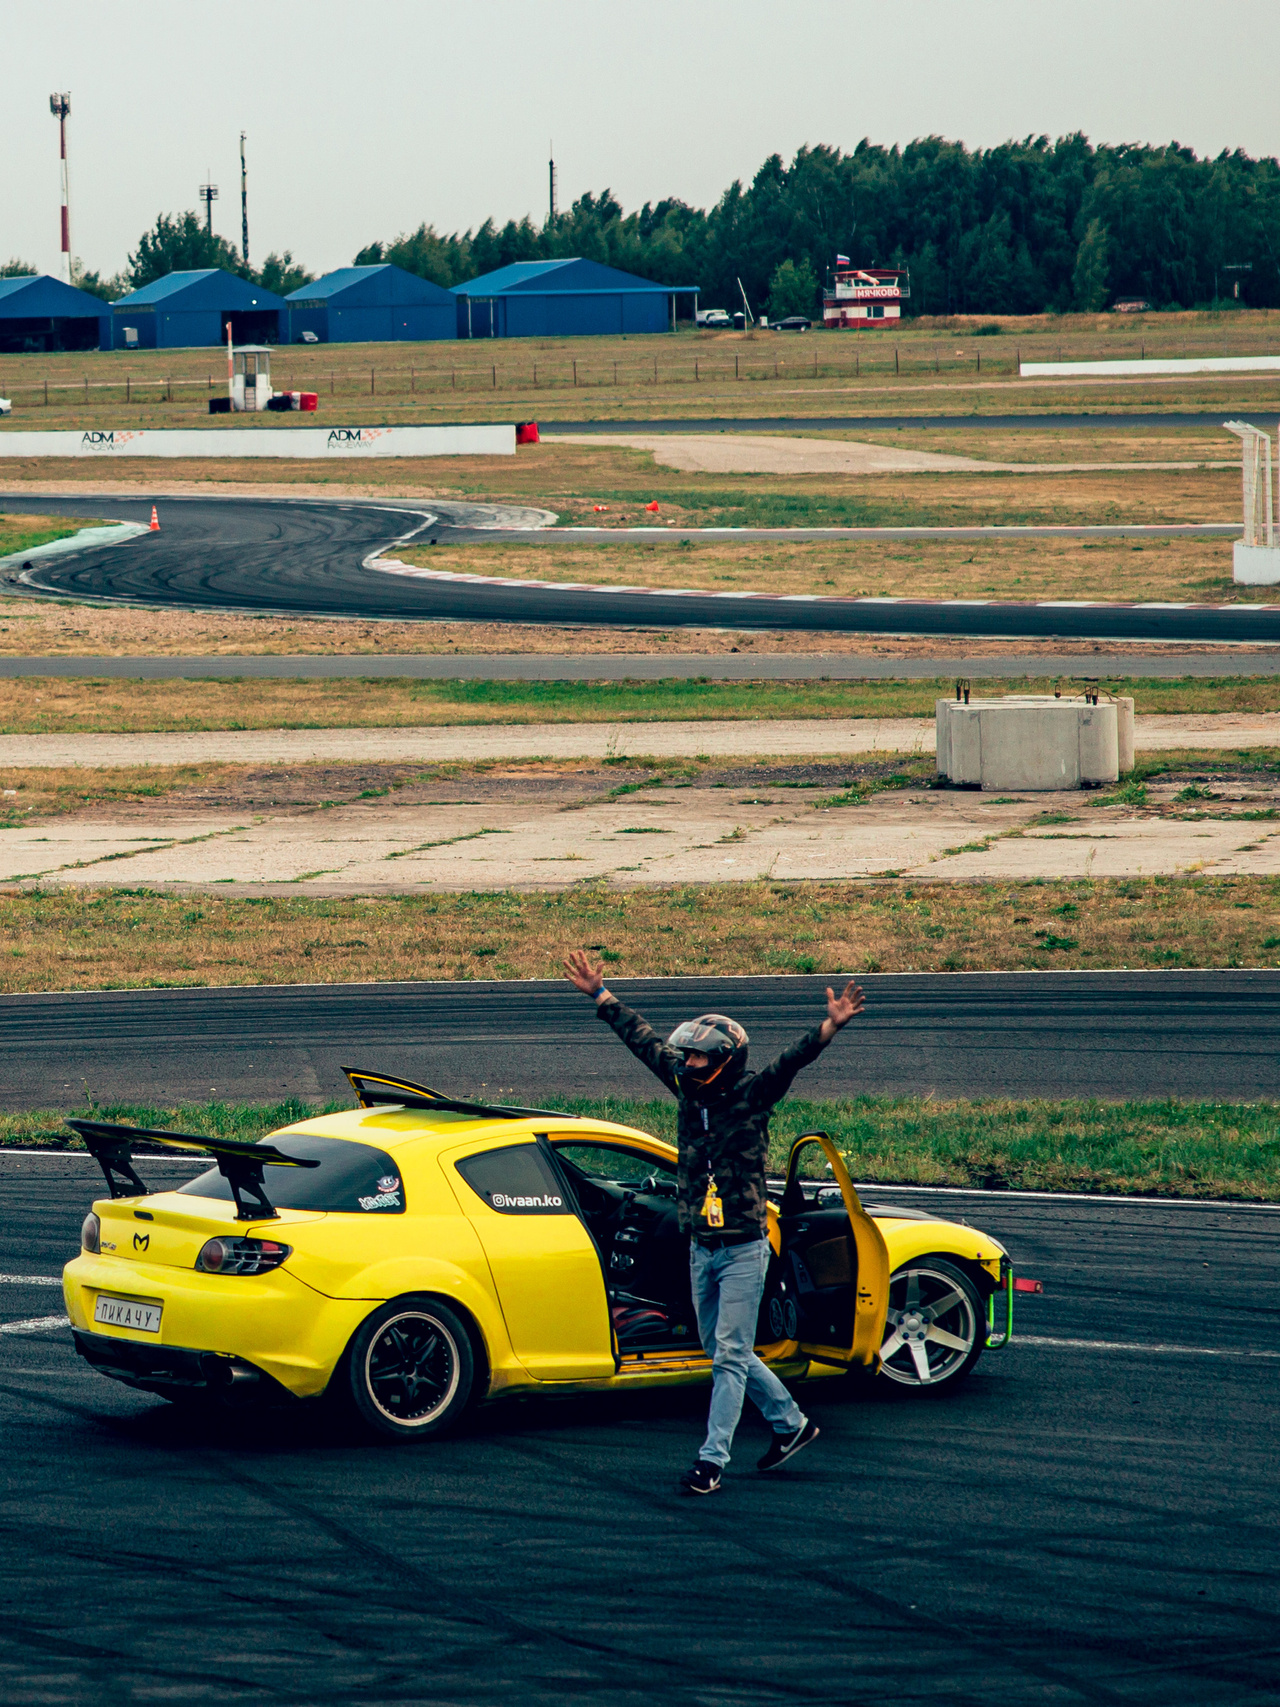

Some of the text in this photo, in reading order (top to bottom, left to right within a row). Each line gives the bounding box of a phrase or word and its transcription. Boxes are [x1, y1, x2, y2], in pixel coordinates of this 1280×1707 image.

[857, 288, 900, 298] МЯЧКОВО
[81, 431, 114, 443] ADM
[327, 429, 361, 441] ADM
[80, 443, 126, 451] RACEWAY
[327, 440, 374, 449] RACEWAY
[101, 1303, 152, 1328] ПИКАЧУ
